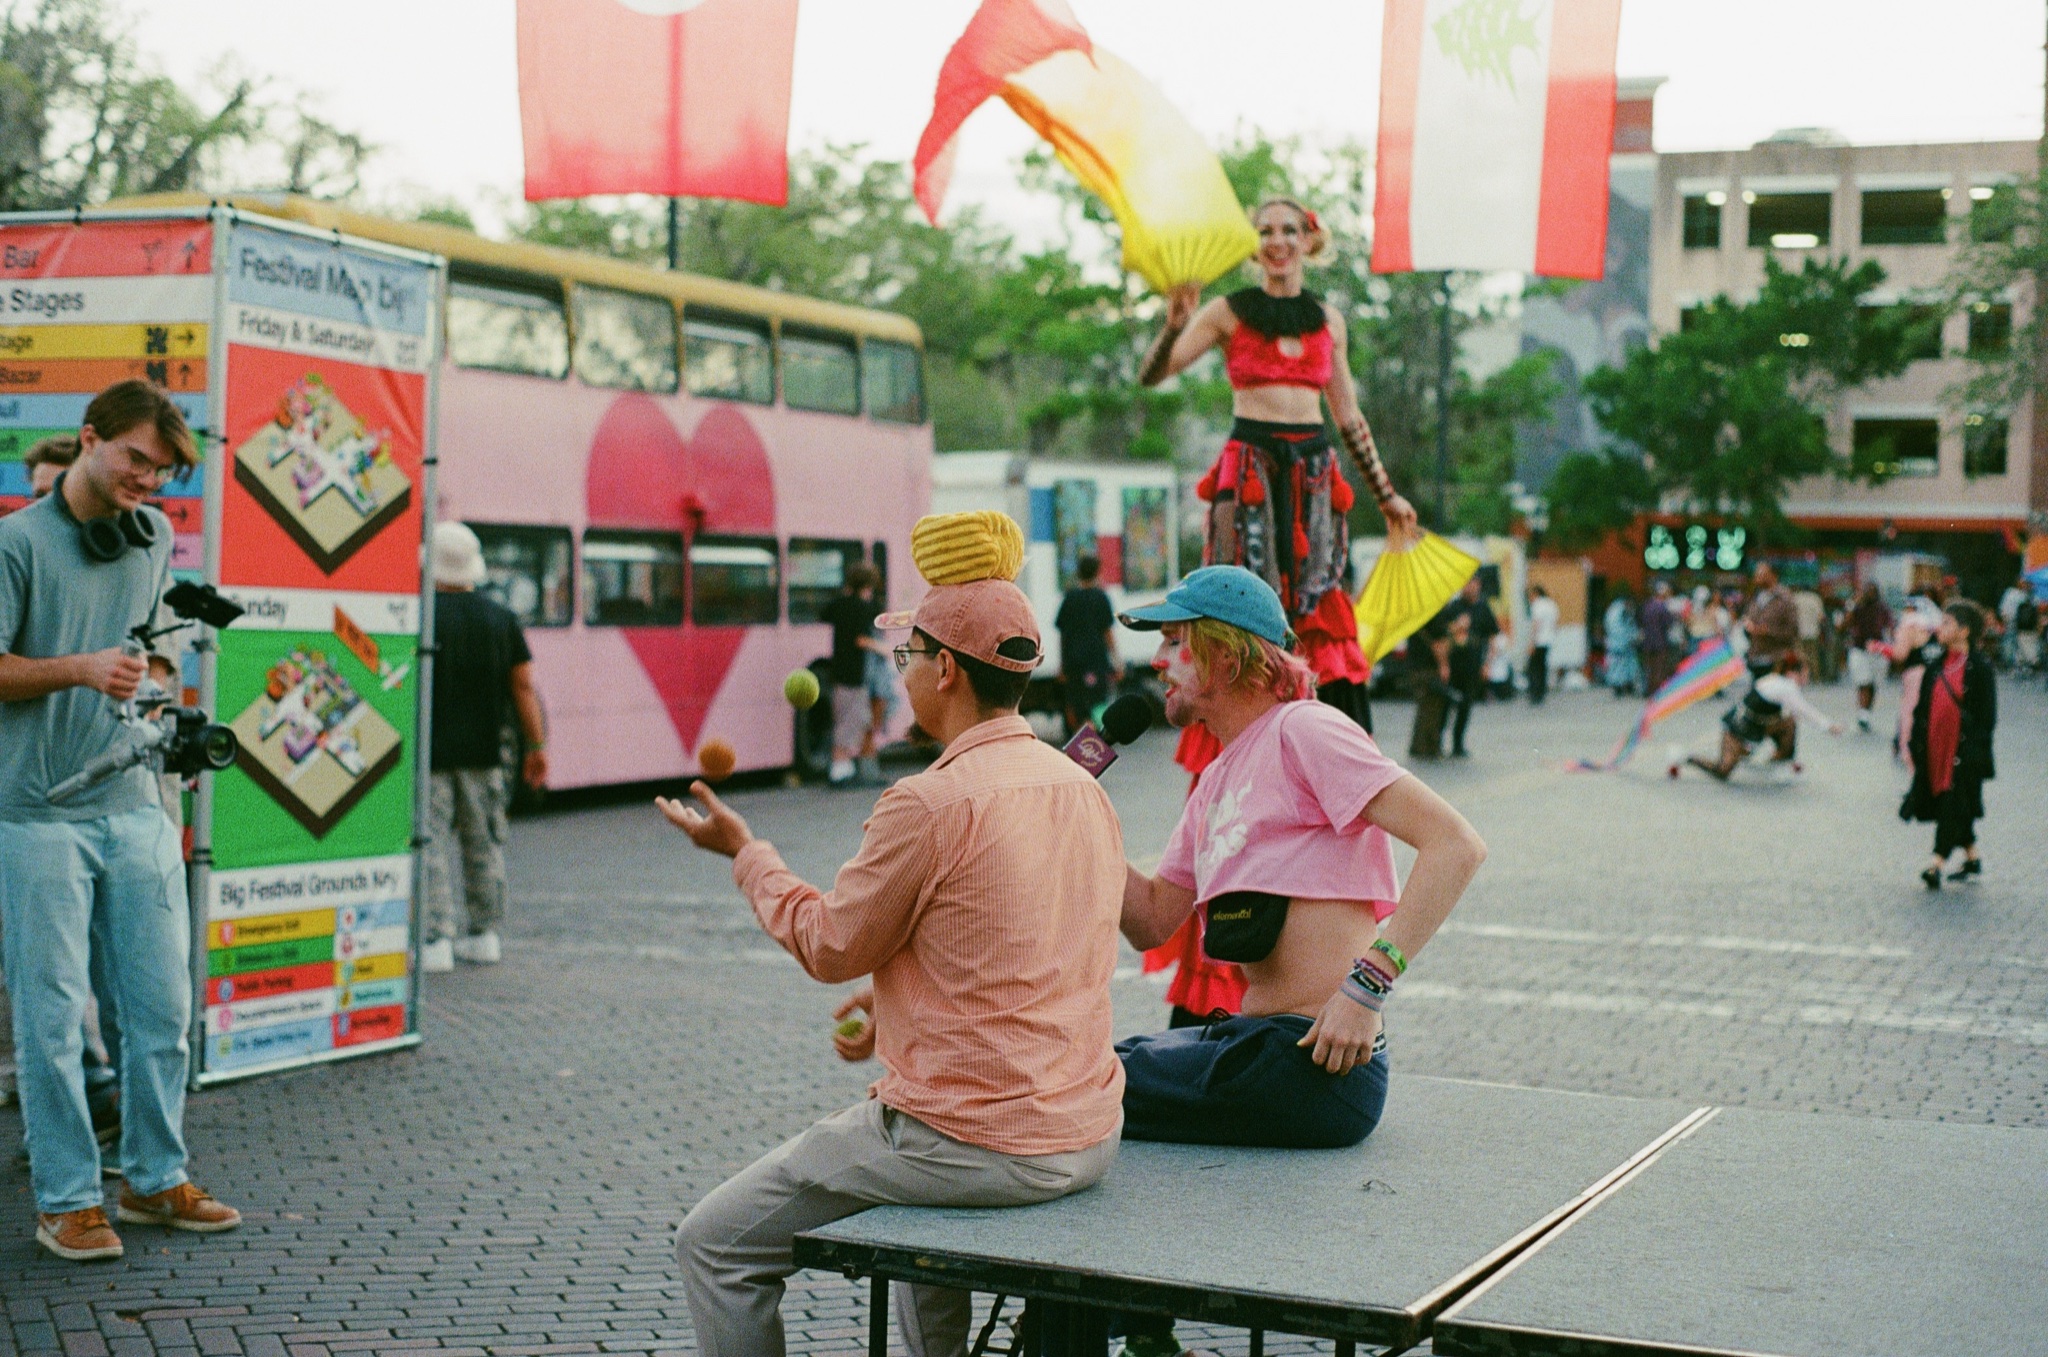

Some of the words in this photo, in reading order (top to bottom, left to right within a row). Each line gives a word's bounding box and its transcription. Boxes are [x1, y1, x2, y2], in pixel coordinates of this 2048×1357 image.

[4, 244, 39, 269] Bar
[239, 247, 321, 292] Festival
[10, 288, 84, 318] Stages
[0, 334, 33, 353] tage
[239, 310, 287, 344] Friday
[307, 322, 377, 356] Saturday
[221, 883, 245, 910] Big
[248, 875, 305, 902] Festival
[308, 871, 367, 896] Grounds
